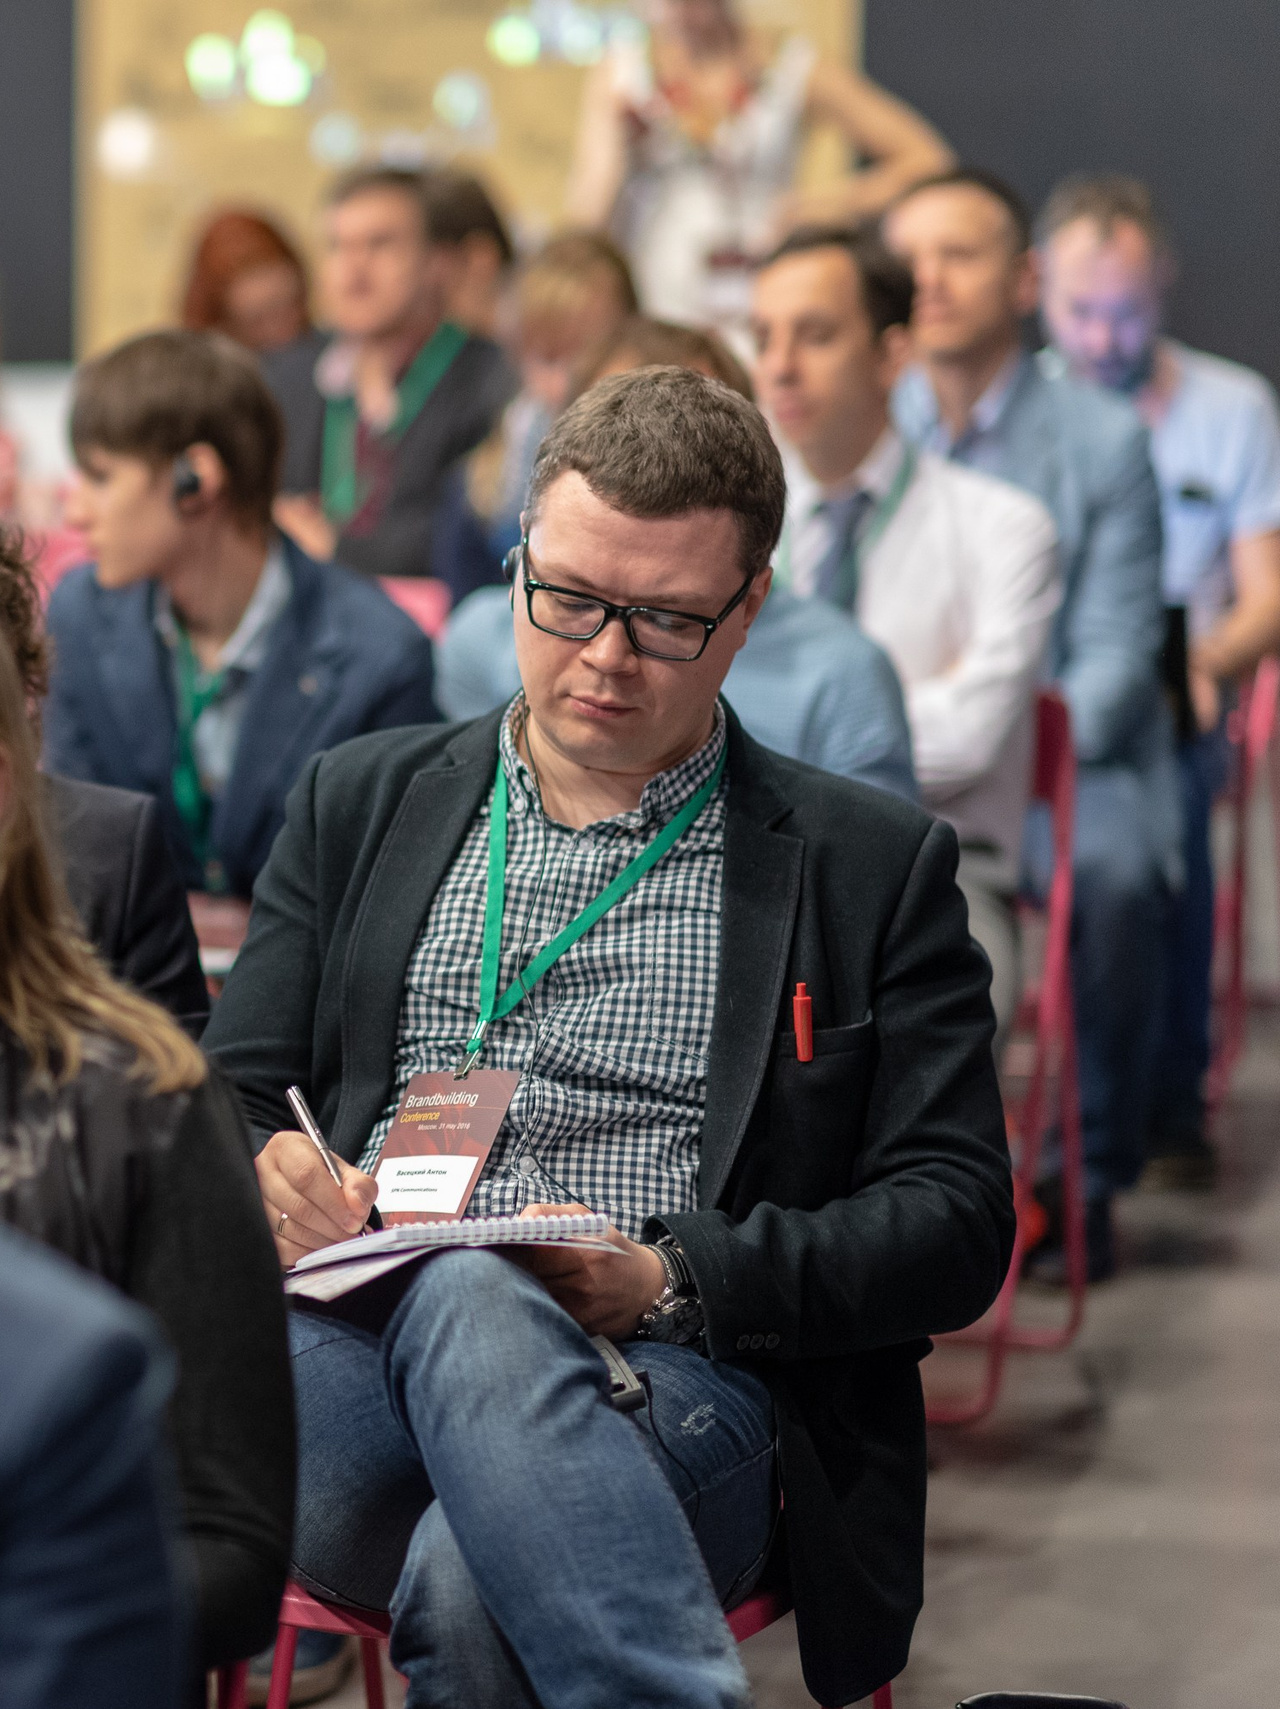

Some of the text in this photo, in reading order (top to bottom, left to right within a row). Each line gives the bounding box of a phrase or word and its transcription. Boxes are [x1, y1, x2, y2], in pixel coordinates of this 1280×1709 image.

[404, 1091, 479, 1108] Brandbuilding
[400, 1111, 440, 1123] Conference
[396, 1168, 426, 1177] Васецкий
